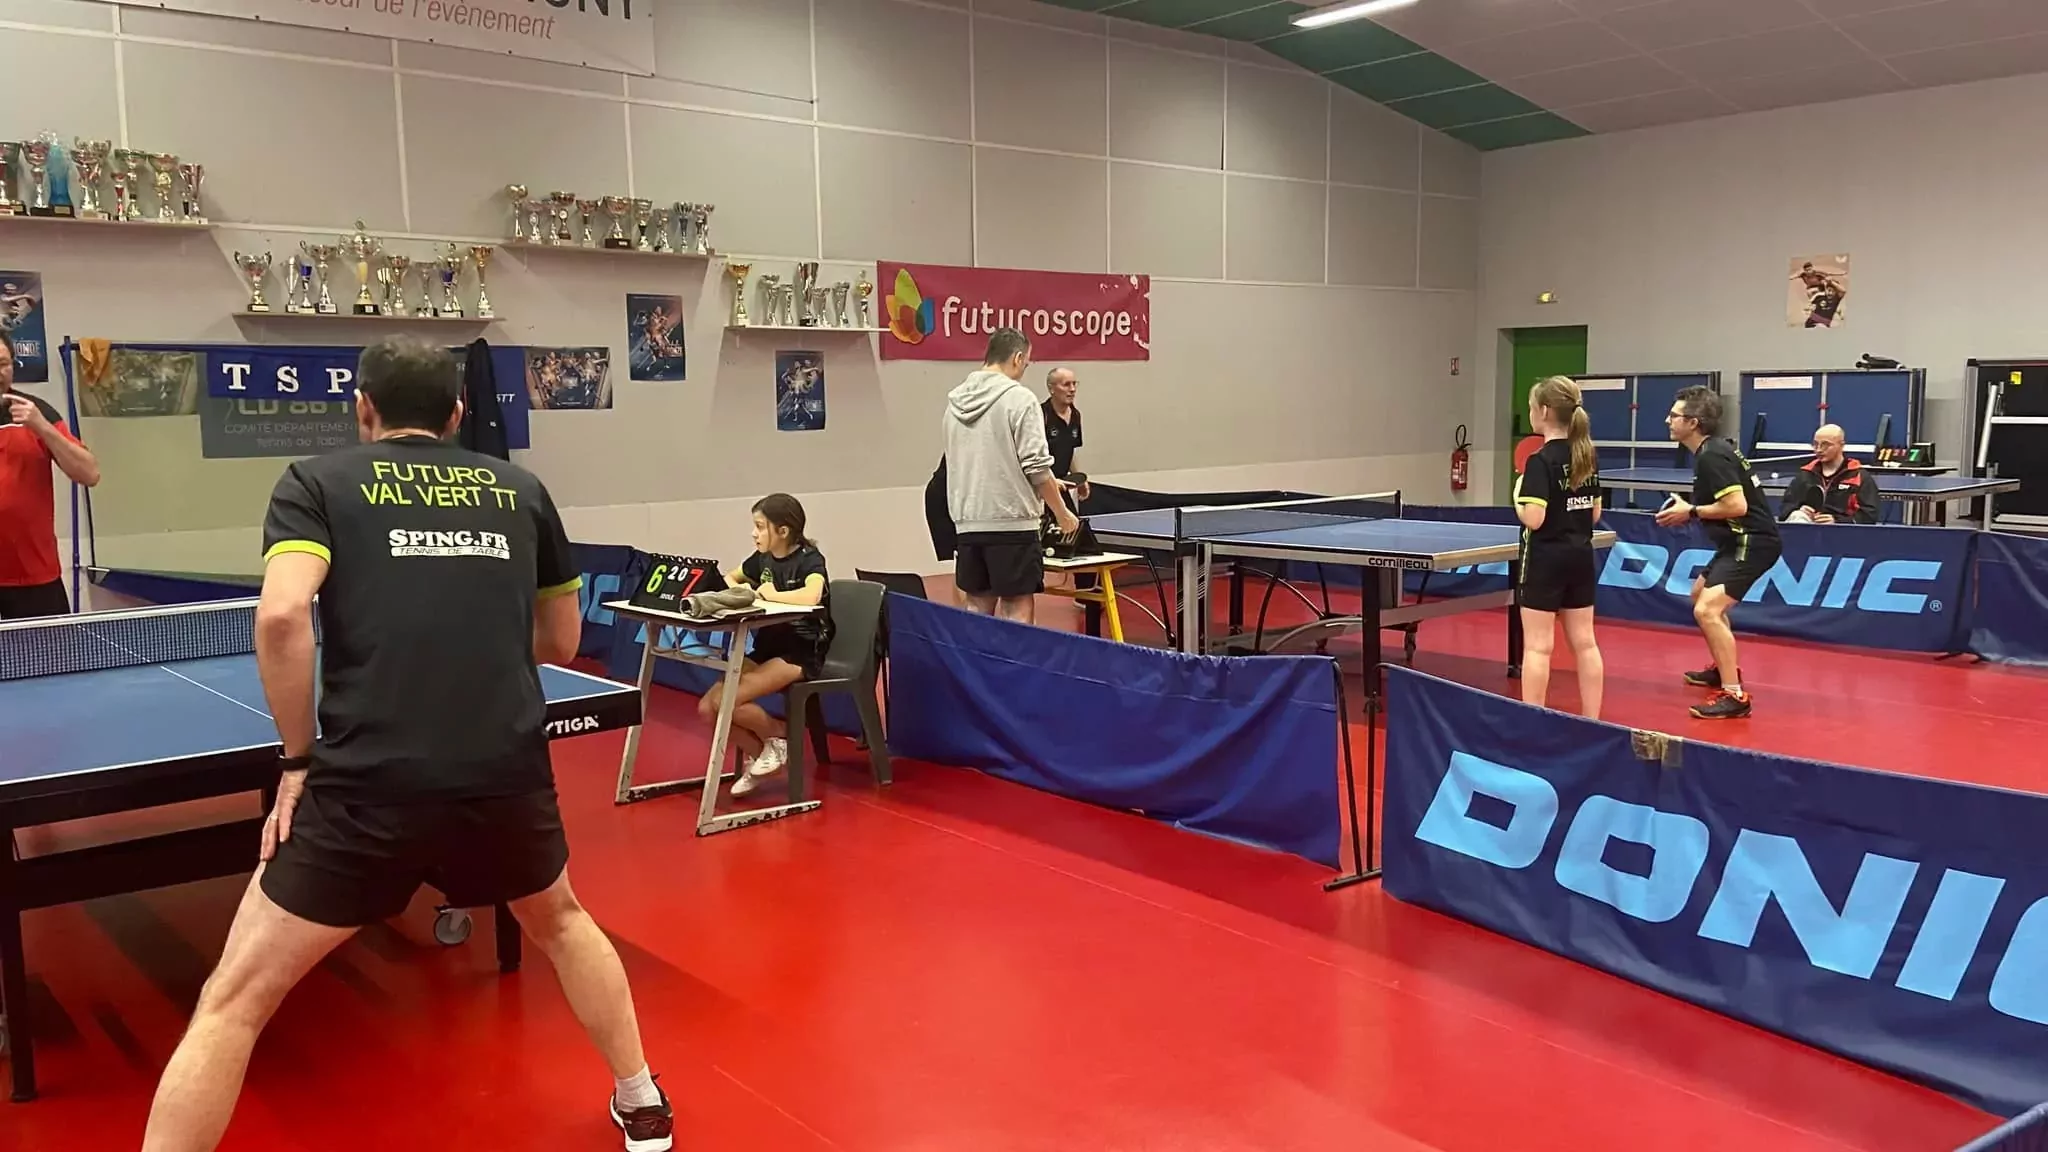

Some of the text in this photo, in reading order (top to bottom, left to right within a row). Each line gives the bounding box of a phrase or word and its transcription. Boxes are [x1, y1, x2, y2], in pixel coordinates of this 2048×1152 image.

[942, 295, 1132, 345] futuroscope
[372, 460, 497, 485] FUTURO
[360, 482, 517, 511] VAL VERT TT
[389, 528, 510, 551] SPING.FR
[399, 546, 505, 557] TENNIS DE TABLE
[1368, 557, 1430, 570] cornilleau
[646, 564, 667, 593] 6
[680, 568, 705, 597] 7
